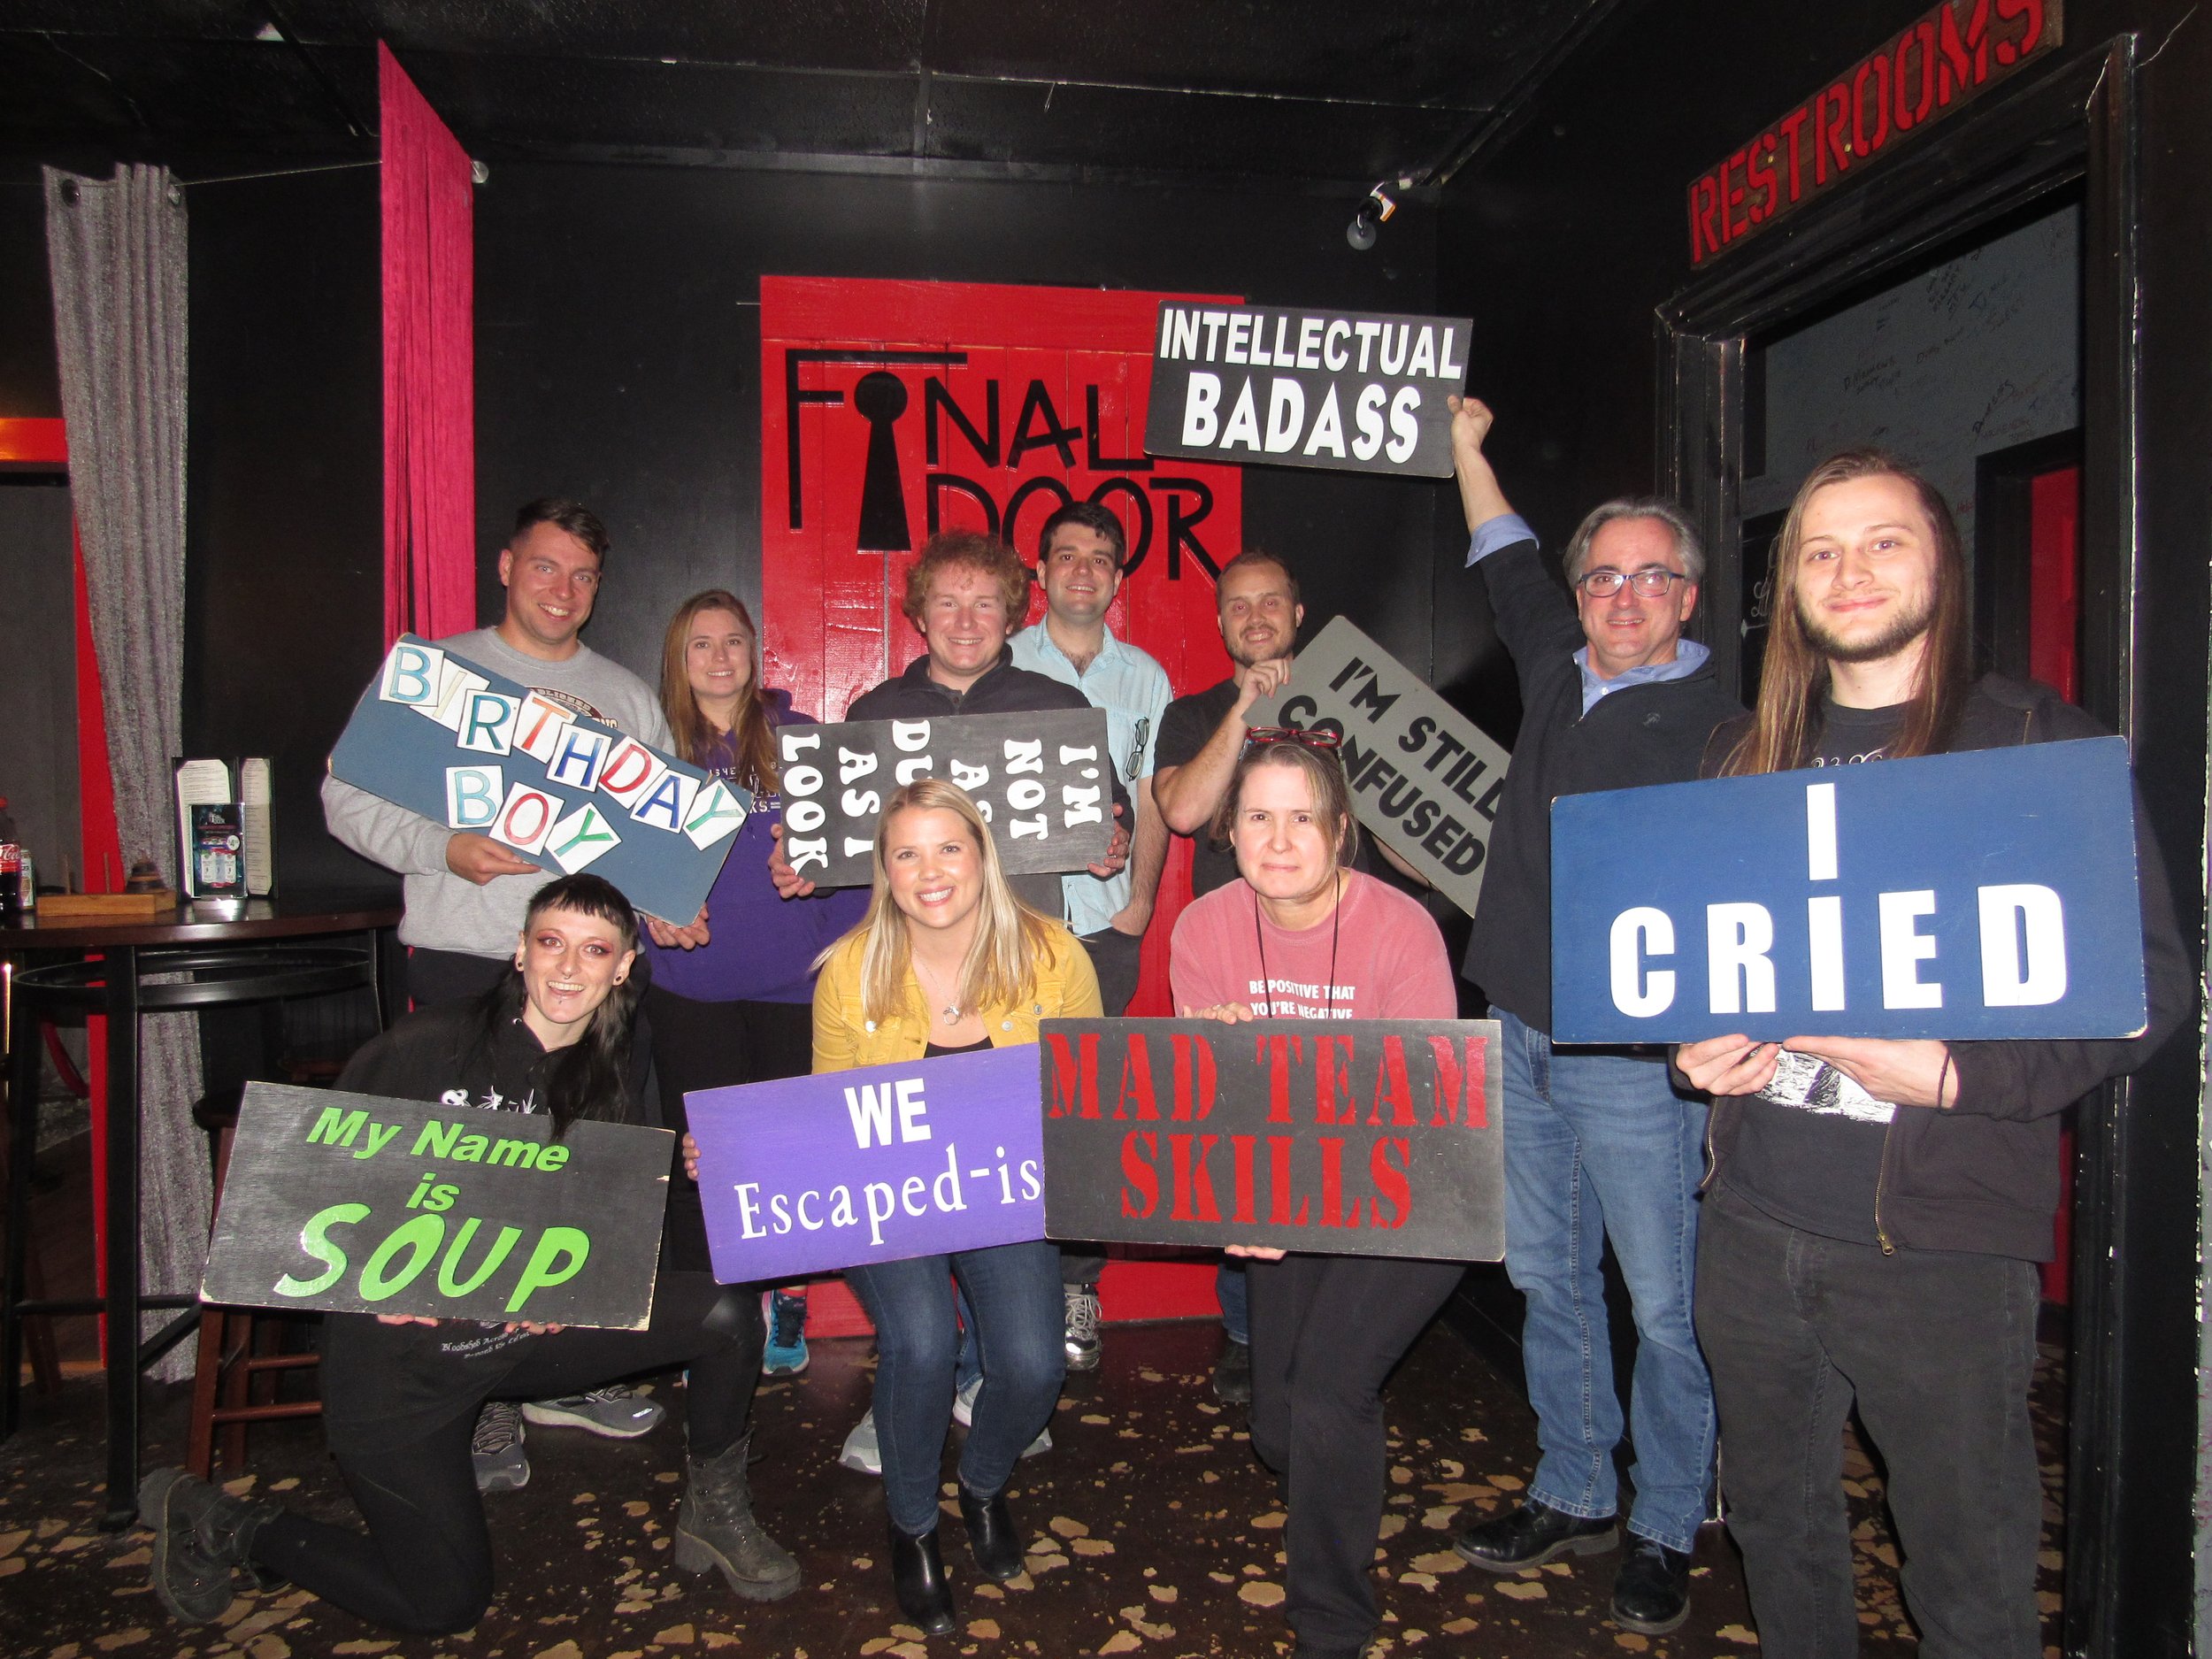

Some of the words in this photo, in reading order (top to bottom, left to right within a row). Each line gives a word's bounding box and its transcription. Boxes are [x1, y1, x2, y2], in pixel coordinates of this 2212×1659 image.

[1691, 0, 2044, 263] RESTROOMS
[1160, 308, 1463, 380] INTELLECTUAL
[1181, 373, 1422, 465] BADASS
[394, 647, 746, 833] BIRTHDAY
[838, 747, 880, 817] AS
[1060, 745, 1102, 828] I'M
[1329, 657, 1402, 724] I'M
[1398, 716, 1505, 823] STILL
[454, 770, 614, 857] BOY
[781, 733, 828, 875] LOOK
[1003, 739, 1050, 841] NOT
[1806, 783, 1838, 880] I
[1248, 980, 1266, 995] BE
[1267, 979, 1319, 999] POSITIVE
[1323, 985, 1356, 1000] THAT
[1609, 884, 2068, 1018] CRIED
[1250, 1001, 1295, 1016] YOU'RE
[1297, 1003, 1353, 1019] NEGATIVE
[843, 1078, 932, 1149] WE
[1045, 1033, 1217, 1122] MAD
[1256, 1034, 1491, 1128] TEAM
[306, 1107, 403, 1159] My
[411, 1120, 570, 1172] Name
[1120, 1130, 1411, 1230] SKILLS
[405, 1172, 460, 1211] is
[273, 1202, 590, 1312] SOUP
